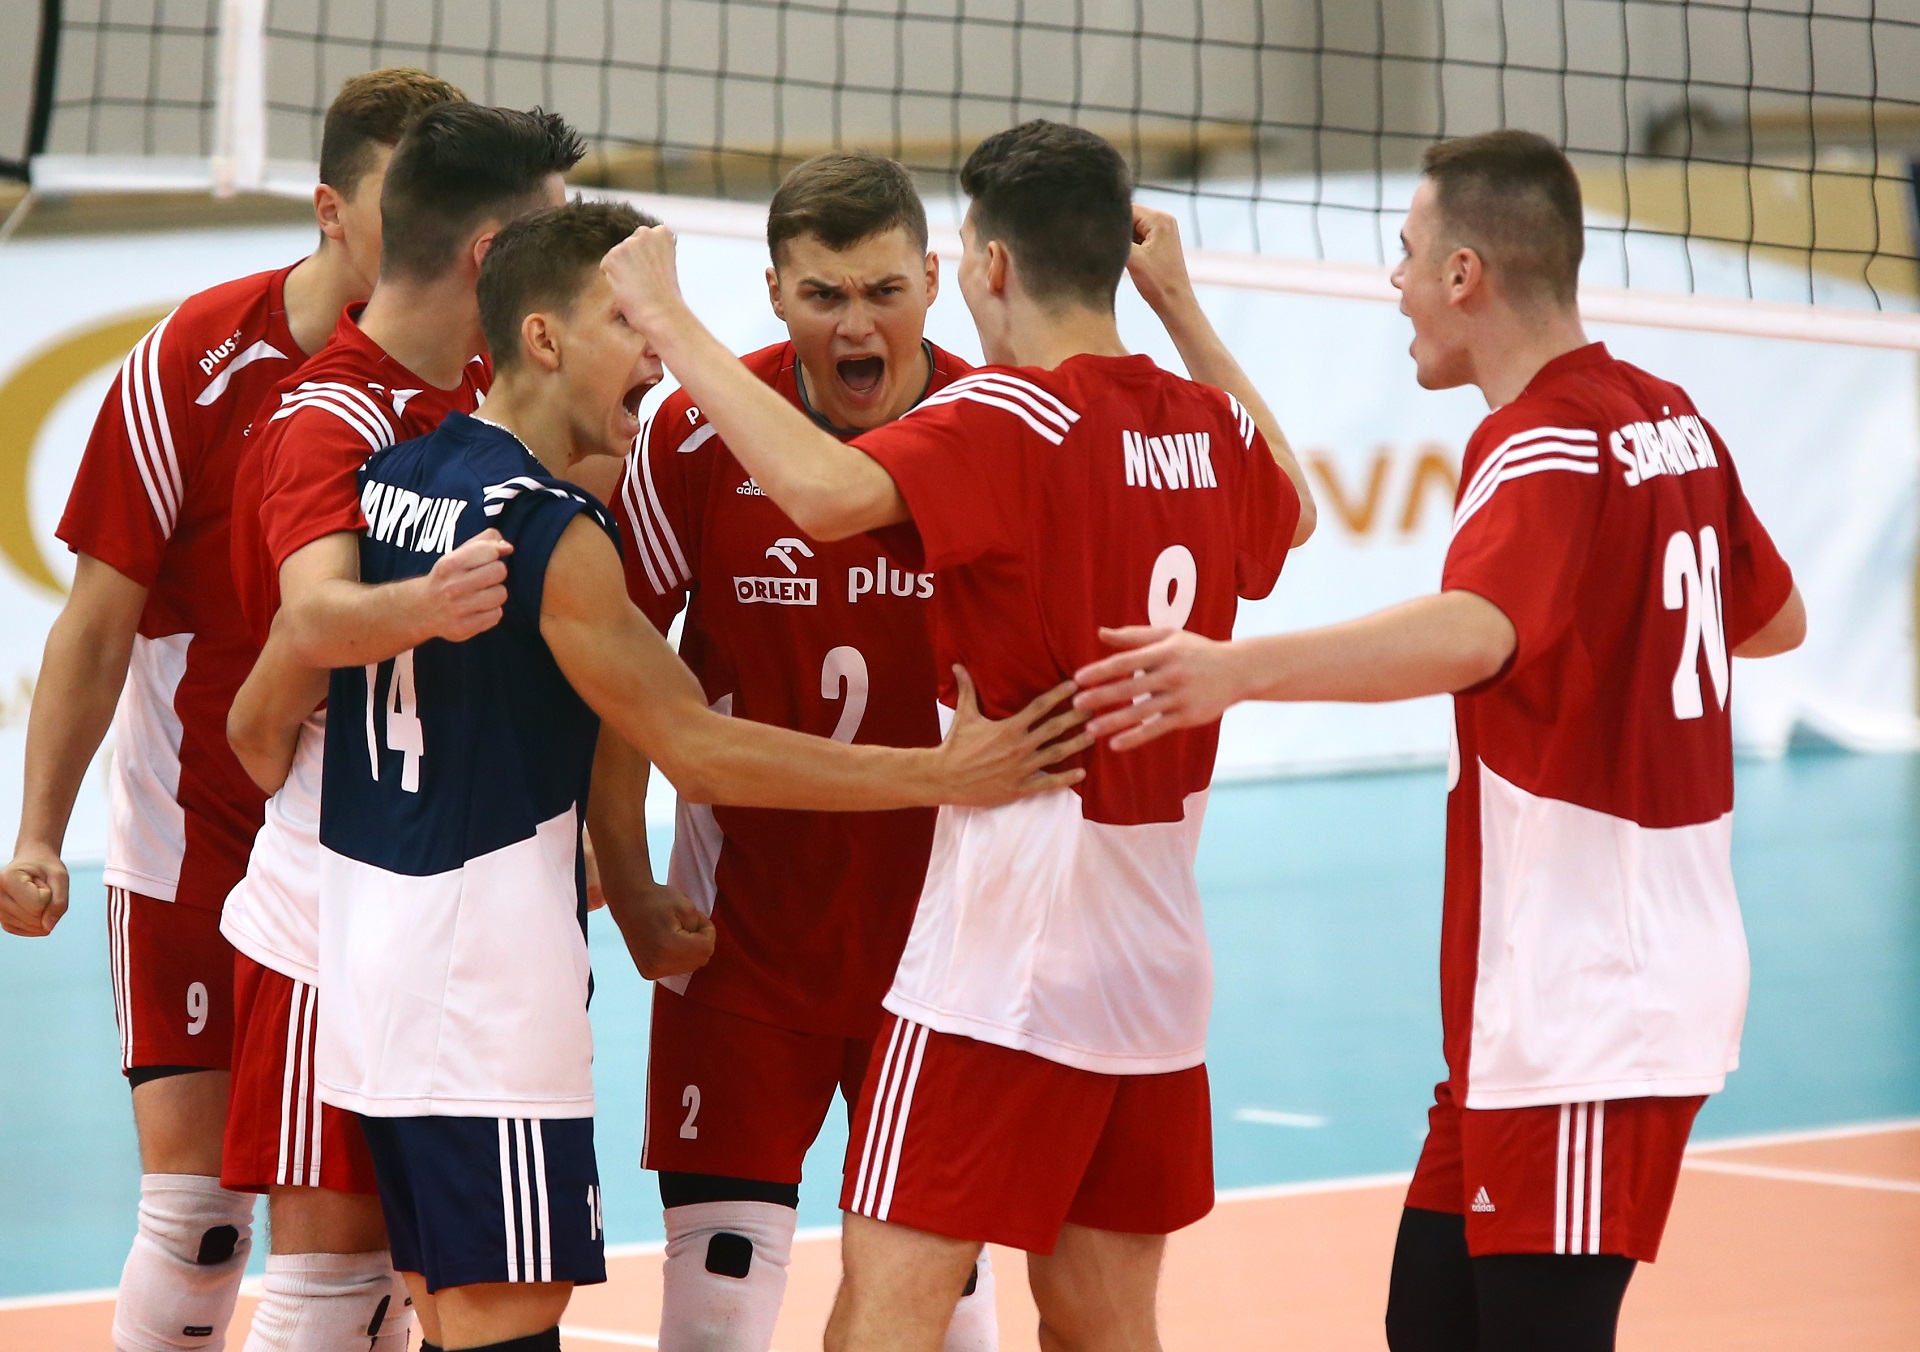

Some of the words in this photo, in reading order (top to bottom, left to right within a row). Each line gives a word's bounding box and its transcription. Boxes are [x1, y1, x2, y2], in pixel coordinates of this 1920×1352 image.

[737, 580, 811, 601] ORLEN
[848, 556, 935, 603] plus
[1663, 525, 1729, 720] 20
[821, 645, 869, 745] 2
[187, 981, 209, 1036] 9
[680, 1084, 701, 1140] 2
